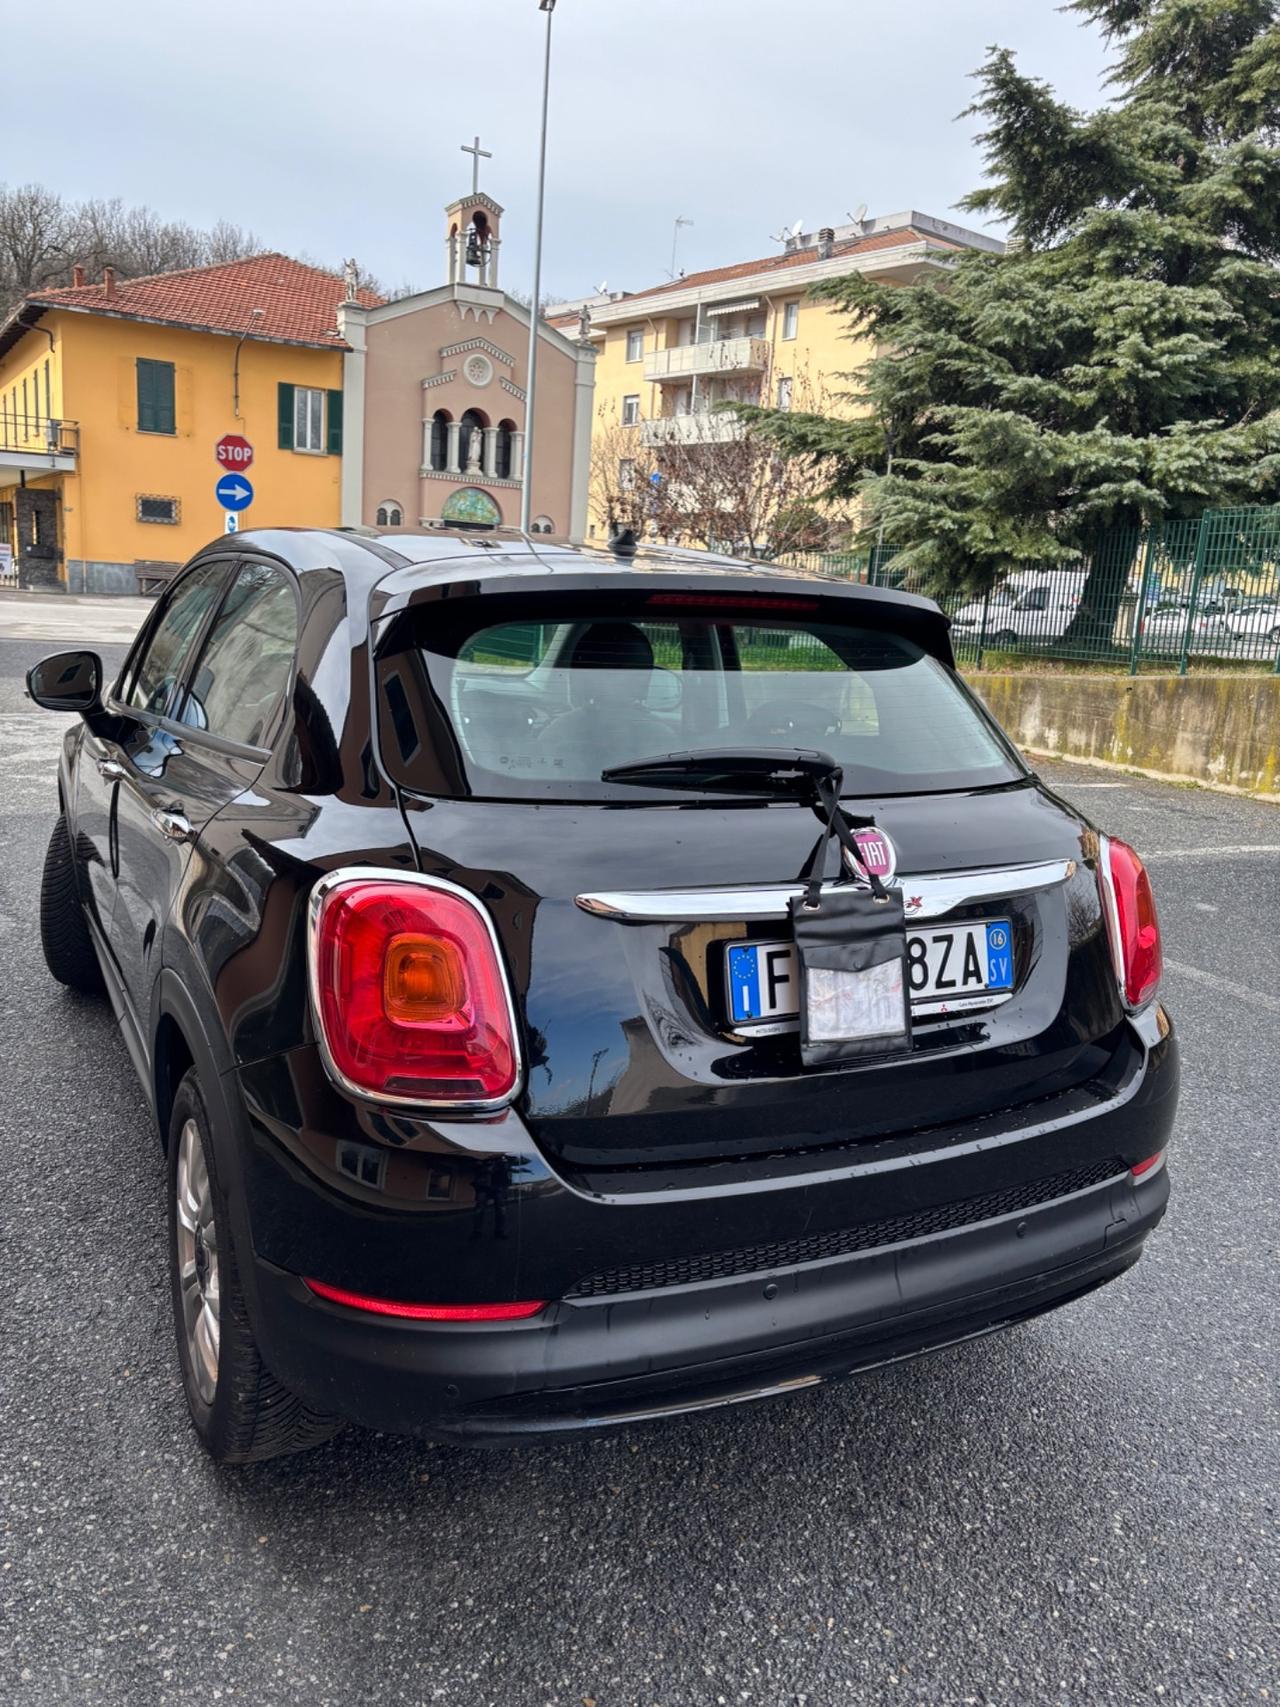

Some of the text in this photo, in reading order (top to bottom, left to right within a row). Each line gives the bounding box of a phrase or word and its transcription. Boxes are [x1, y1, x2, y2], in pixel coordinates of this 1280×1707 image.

[218, 445, 252, 461] STOP
[991, 932, 1004, 946] 16
[990, 956, 1008, 982] SV
